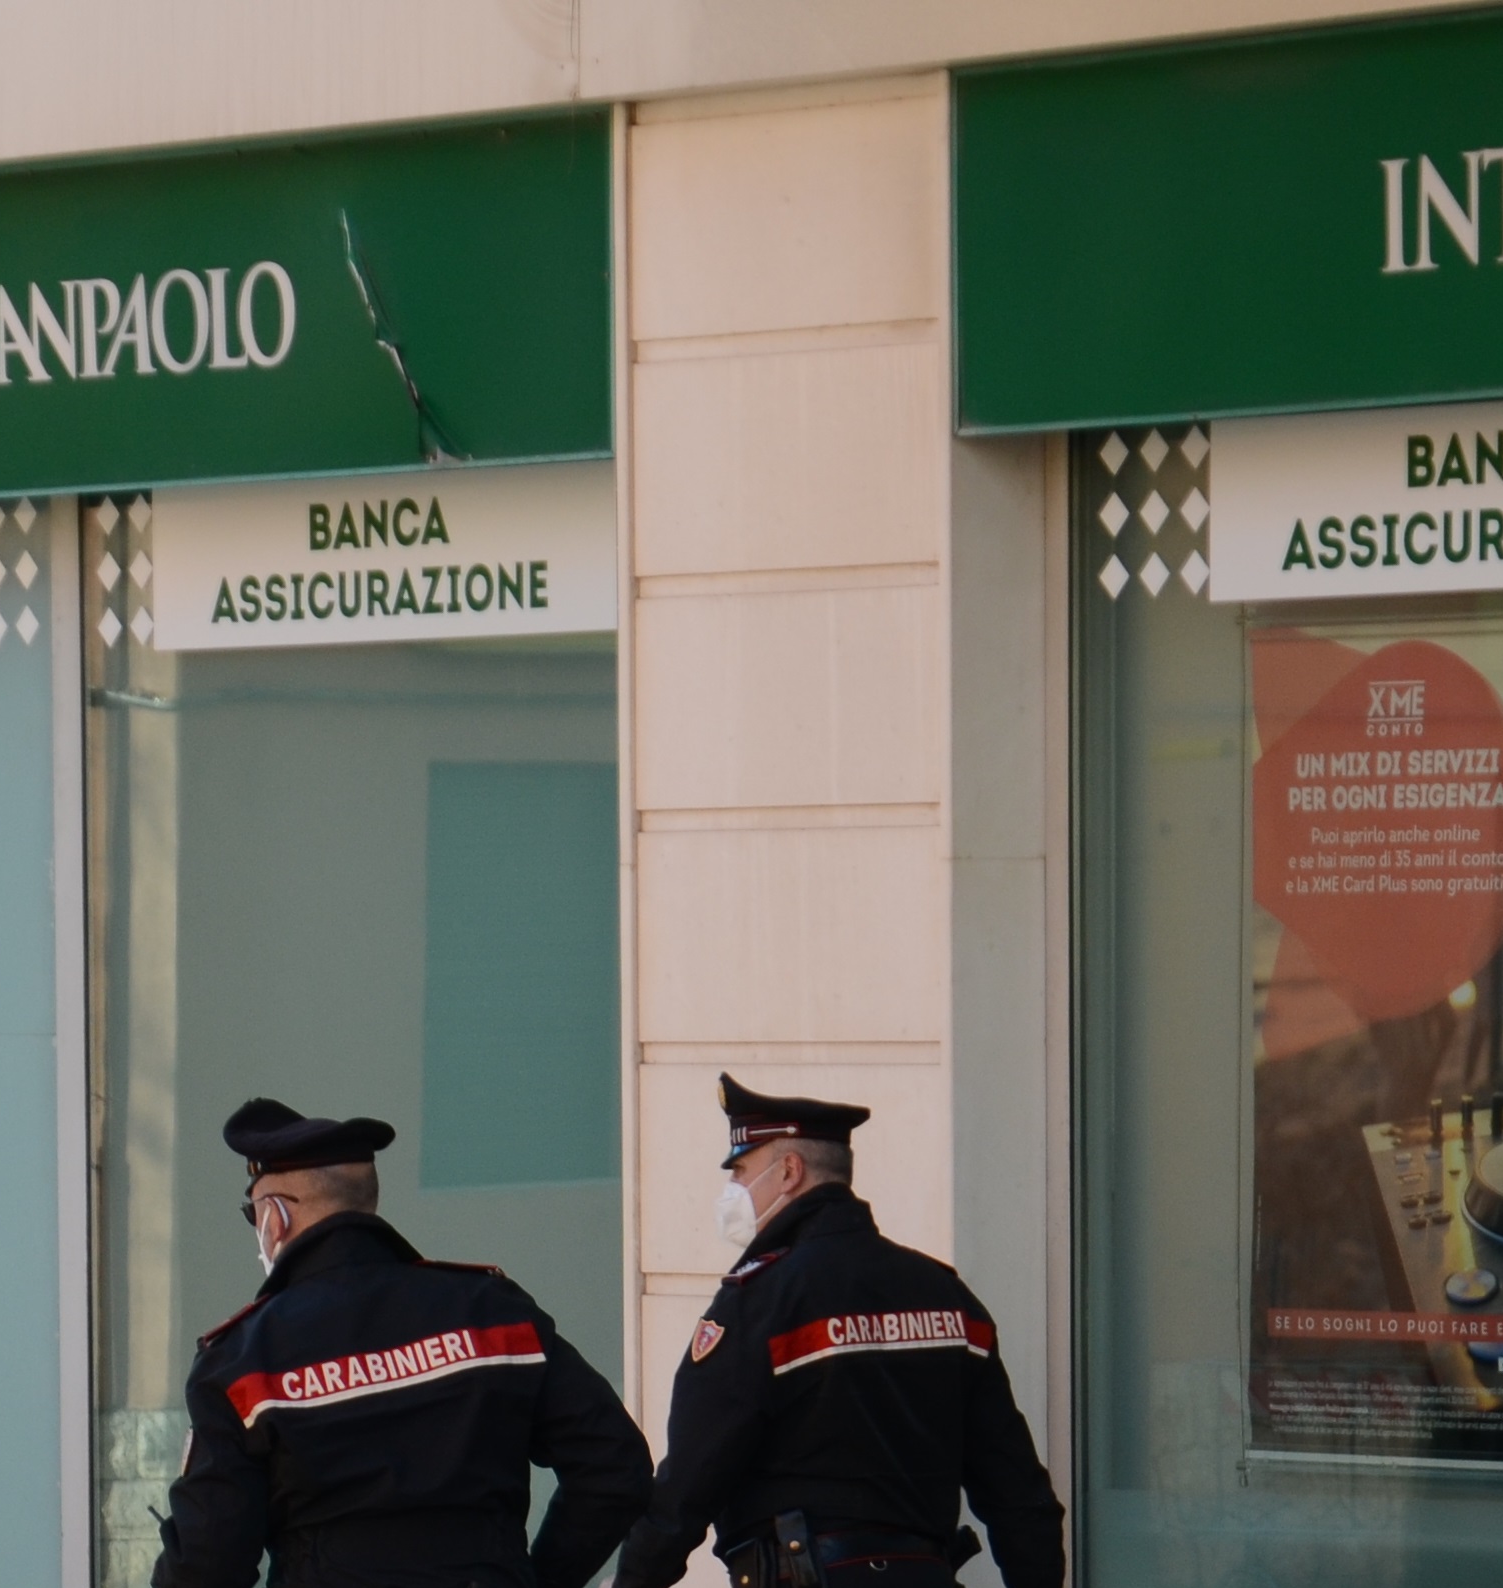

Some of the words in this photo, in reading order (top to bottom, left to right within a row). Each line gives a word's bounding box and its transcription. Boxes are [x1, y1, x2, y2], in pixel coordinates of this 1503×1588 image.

[309, 497, 449, 551] BANCA
[211, 561, 549, 626] ASSICURAZIONE
[1367, 724, 1424, 736] CONTO
[1296, 753, 1325, 777] UN
[1331, 752, 1371, 776] MIX
[1376, 751, 1401, 775] DI
[1408, 748, 1499, 775] SERVIZI
[1288, 786, 1327, 811] PER
[1332, 784, 1387, 810] OGNI
[1311, 827, 1339, 844] Puoi
[1343, 826, 1385, 845] aprirlo
[1389, 825, 1430, 843] anche
[1434, 824, 1480, 842] online
[1288, 856, 1296, 868] e
[1299, 855, 1314, 868] se
[1317, 852, 1337, 868] hai
[1340, 854, 1376, 868] meno
[1379, 851, 1392, 867] di
[1395, 850, 1410, 867] 35
[1414, 850, 1444, 867] anni
[1448, 850, 1458, 866] il
[1285, 881, 1293, 893] e
[1296, 876, 1308, 893] la
[1311, 876, 1339, 893] XME
[1343, 875, 1374, 893] Card
[1379, 875, 1407, 892] Plus
[1410, 879, 1444, 891] sono
[825, 1309, 965, 1345] CARABINIERI
[1275, 1316, 1290, 1329] SE
[1298, 1317, 1314, 1330] LO
[1323, 1318, 1371, 1331] SOGNI
[1380, 1319, 1398, 1332] LO
[1407, 1320, 1445, 1334] PUOI
[1452, 1322, 1488, 1335] FARE
[1497, 1323, 1503, 1335] E
[281, 1330, 474, 1401] CARABINIERI
